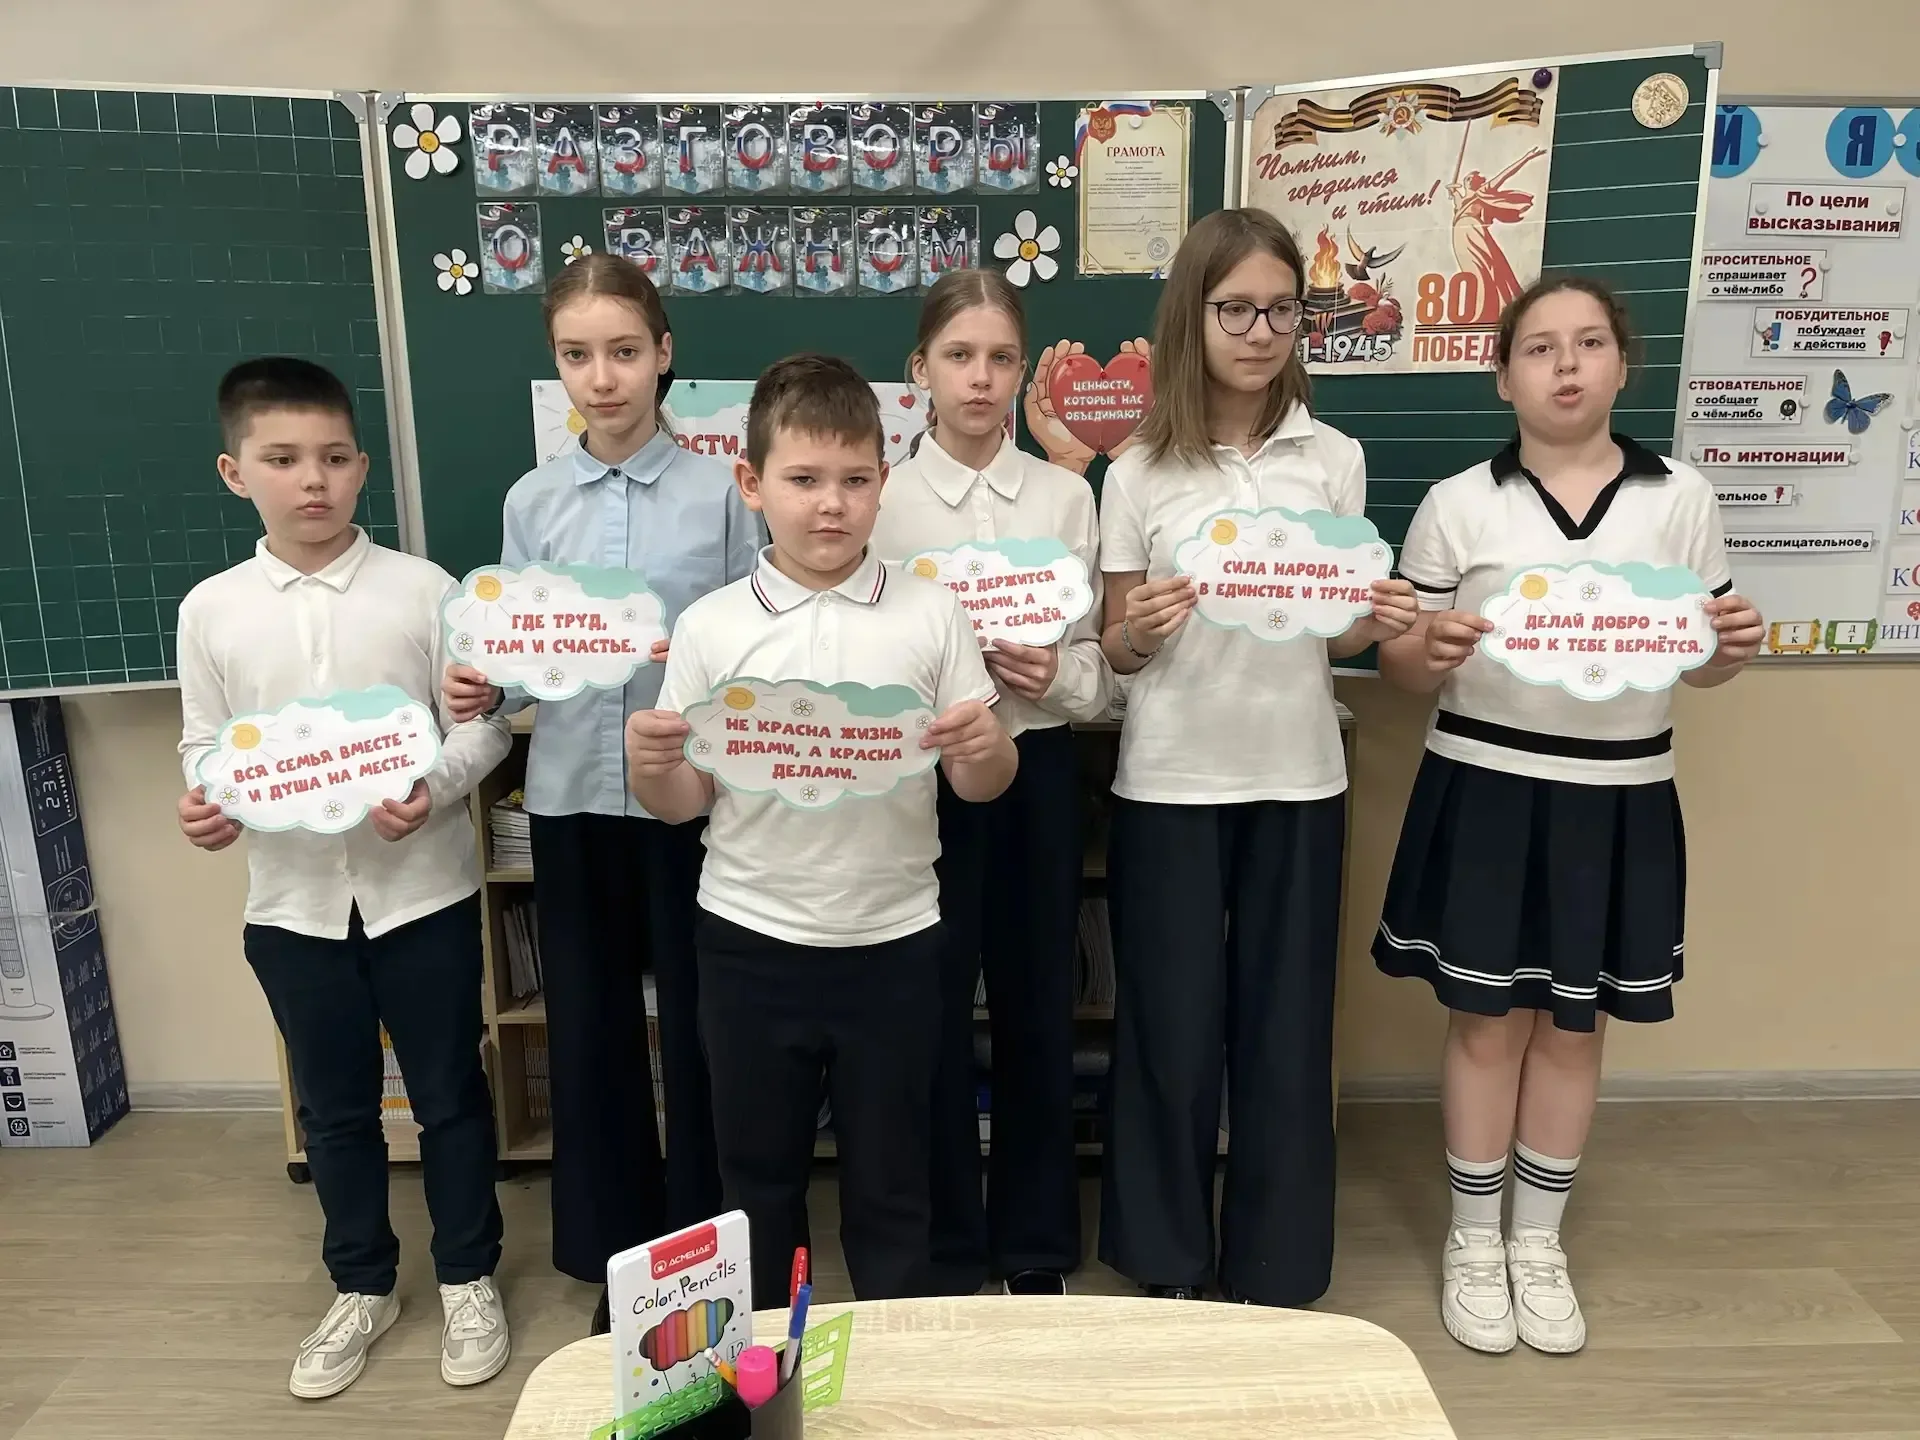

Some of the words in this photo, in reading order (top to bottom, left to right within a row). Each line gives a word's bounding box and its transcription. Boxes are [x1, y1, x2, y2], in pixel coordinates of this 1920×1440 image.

[486, 122, 1027, 175] РАЗГОВОРЫ
[1106, 146, 1165, 157] ГРАМОТА
[1256, 149, 1367, 181] Помним,
[1287, 166, 1399, 206] гордимся
[1332, 204, 1348, 220] и
[1357, 179, 1441, 217] чтим!
[1786, 191, 1814, 208] По
[1820, 193, 1869, 210] цели
[1748, 216, 1900, 233] высказывания
[492, 224, 531, 271] О
[620, 226, 969, 274] ВАЖНОМ
[1701, 255, 1811, 266] ПРОСИТЕЛЬНОЕ
[1707, 271, 1787, 281] спрашивает
[1416, 271, 1478, 325] 80
[1723, 284, 1784, 295] чём-либо
[1775, 310, 1890, 322] ПОБУДИТЕЛЬНОЕ
[1797, 326, 1866, 337] побуждает
[1301, 333, 1392, 363] 1-1945
[1412, 335, 1498, 366] ПОБЕД
[1793, 340, 1801, 349] к
[1804, 339, 1867, 350] действию
[1072, 380, 1134, 392] ЦЕННОСТИ,
[1688, 380, 1804, 391] СТВОВАТЕЛЬНОЕ
[1063, 396, 1117, 407] КОТОРЫЕ
[1121, 394, 1144, 405] НАС
[1695, 396, 1759, 406] сообщает
[1065, 409, 1142, 422] ОБЪЕДИНЯЮТ
[1703, 408, 1763, 419] чём-либо
[674, 434, 748, 459] ОСТИ,
[1703, 448, 1731, 463] По
[1737, 451, 1845, 466] интонации
[1222, 561, 1267, 576] СИЛА
[1274, 562, 1340, 580] НАРОДА
[976, 570, 1056, 593] ДЕРЖИТСЯ
[1199, 583, 1209, 596] В
[1216, 583, 1295, 599] ЕДИНСТВЕ
[1302, 586, 1312, 599] И
[961, 595, 1018, 612] РНЯМИ,
[1025, 593, 1036, 605] А
[511, 614, 545, 631] ГДЕ
[553, 613, 608, 632] ТРУД,
[1004, 607, 1067, 628] СЕМЬЁЙ.
[1524, 613, 1584, 631] ДЕЛАЙ
[1592, 615, 1650, 632] ДОБРО
[1676, 616, 1688, 630] И
[484, 640, 524, 655] ТАМ
[532, 640, 544, 654] И
[553, 638, 637, 655] СЧАСТЬЕ.
[1505, 637, 1540, 651] ОНО
[1548, 638, 1560, 651] К
[1568, 638, 1607, 653] ТЕБЕ
[1614, 635, 1704, 654] ВЕРНЁТСЯ.
[726, 717, 749, 732] НЕ
[757, 720, 832, 739] КРАСНА
[840, 727, 904, 740] ЖИЗНЬ
[233, 765, 268, 783] ВСЯ
[276, 749, 333, 774] СЕМЬЯ
[340, 732, 402, 760] ВМЕСТЕ
[726, 740, 801, 758] ДНЯМИ,
[808, 745, 822, 758] А
[830, 747, 903, 761] КРАСНА
[248, 789, 262, 803] И
[269, 778, 322, 802] ДУША
[327, 768, 352, 786] НА
[359, 754, 416, 777] МЕСТЕ.
[772, 763, 857, 781] ДЕЛАМИ.
[632, 1287, 677, 1315] Color
[679, 1258, 737, 1298] Pencils
